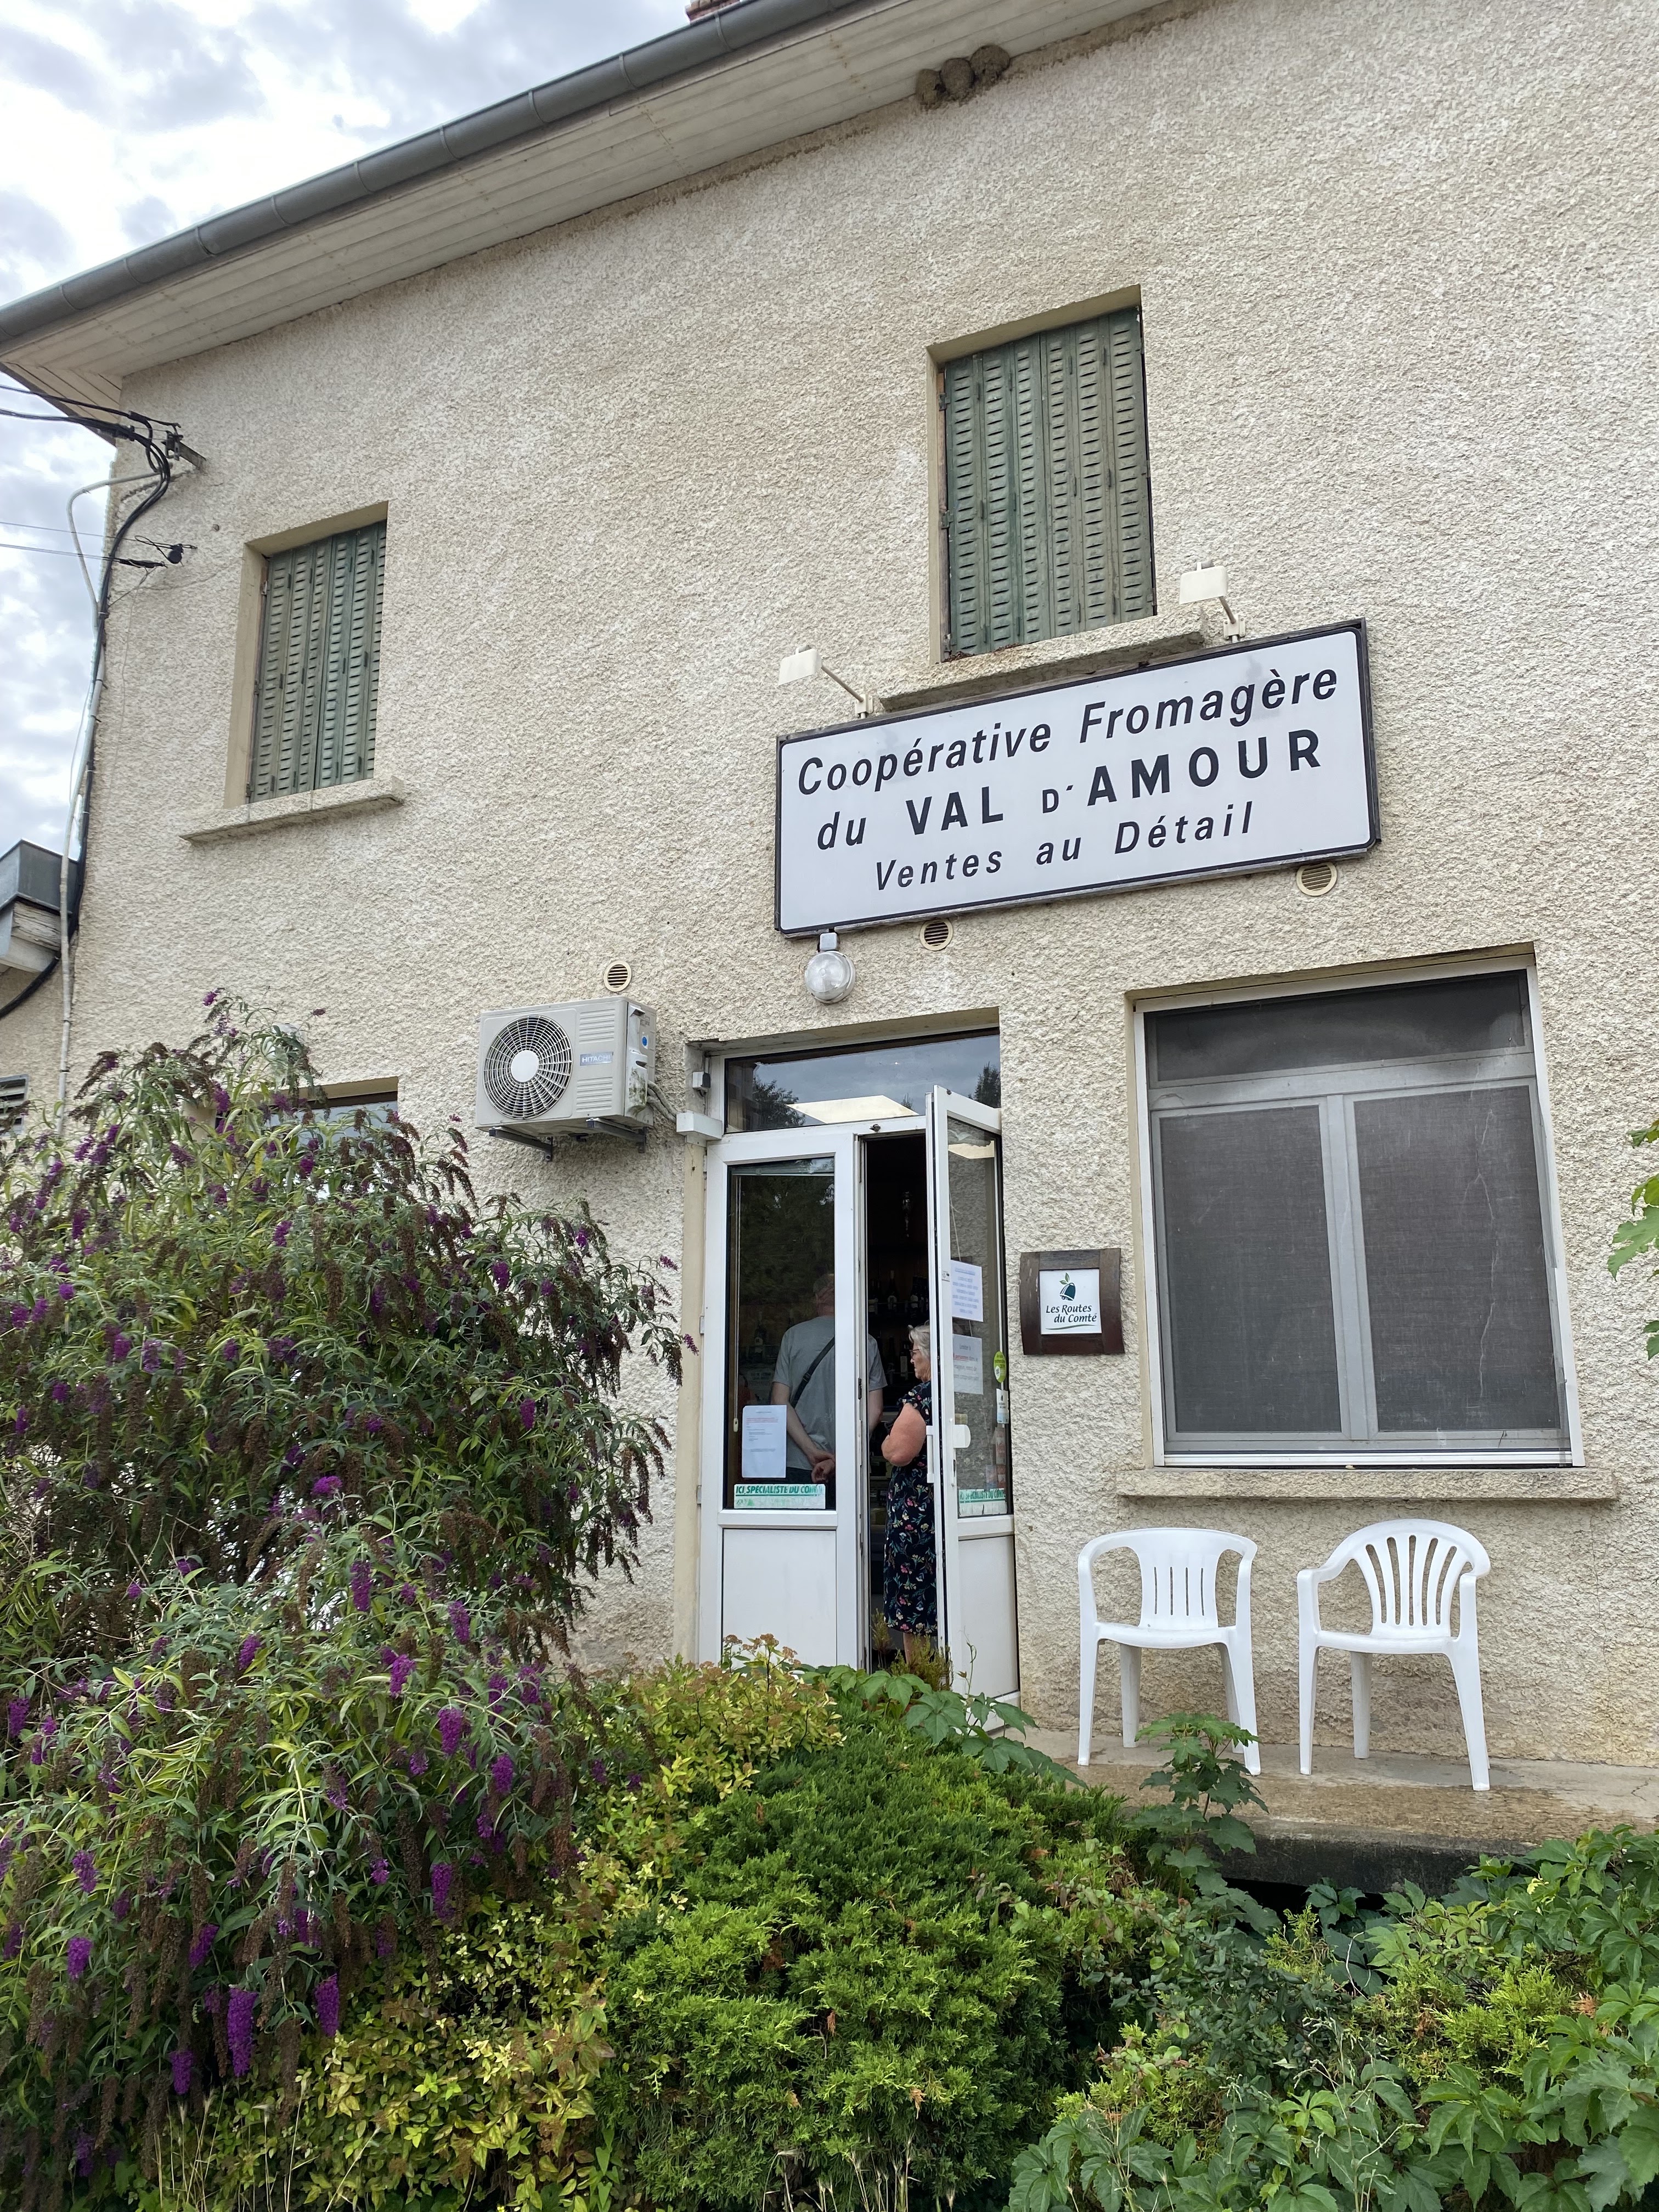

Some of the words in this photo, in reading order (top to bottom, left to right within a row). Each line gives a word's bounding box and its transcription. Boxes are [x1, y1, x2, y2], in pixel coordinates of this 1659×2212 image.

[798, 724, 1051, 795] Coopérative
[1079, 668, 1337, 743] Fromagère
[817, 811, 867, 850] du
[905, 786, 1003, 836] VAL
[876, 851, 1002, 890] Ventes
[1036, 837, 1081, 865] au
[1114, 800, 1252, 854] Détail
[582, 1054, 611, 1063] HITACHI
[1046, 1305, 1059, 1313] Les
[1062, 1304, 1092, 1315] Routes
[1054, 1314, 1065, 1323] du
[1068, 1313, 1098, 1323] Comté
[789, 1486, 799, 1494] DU
